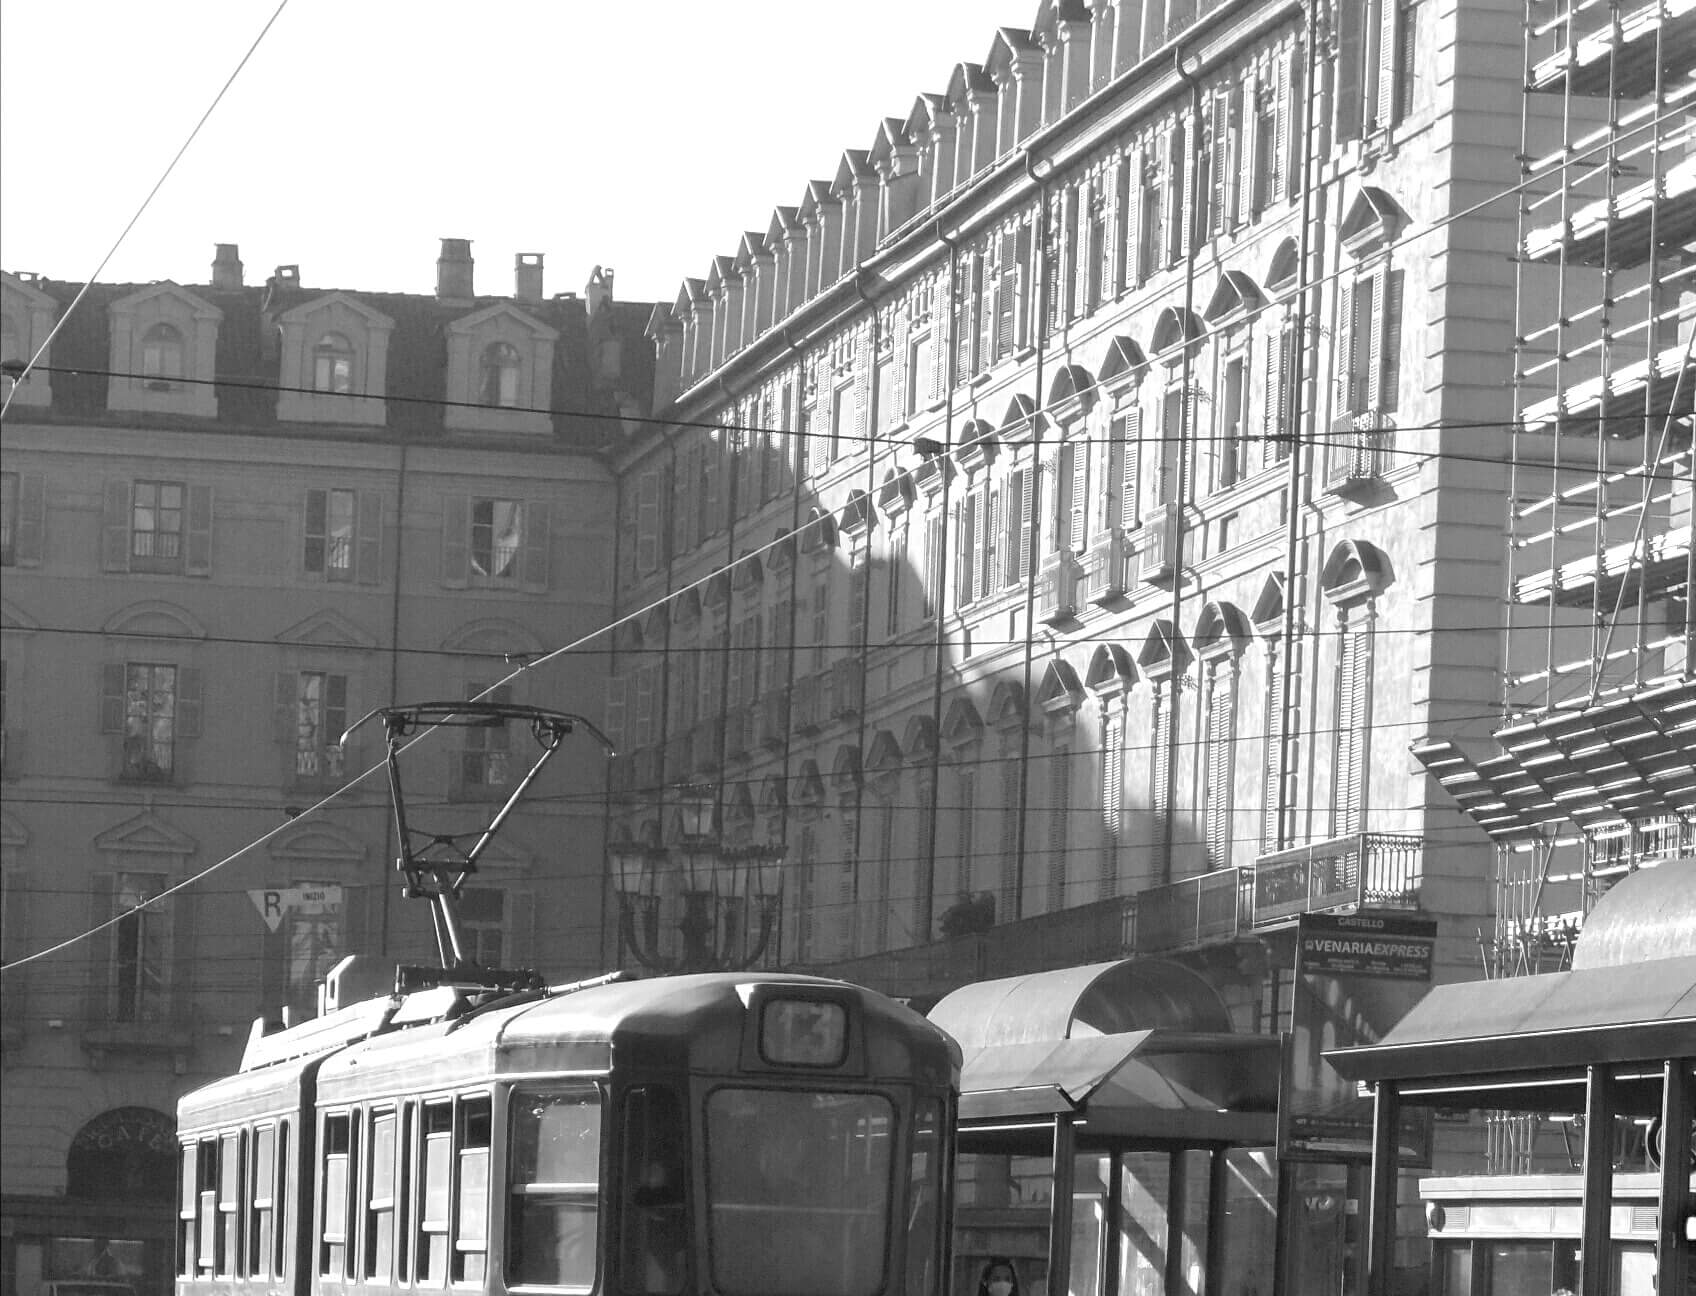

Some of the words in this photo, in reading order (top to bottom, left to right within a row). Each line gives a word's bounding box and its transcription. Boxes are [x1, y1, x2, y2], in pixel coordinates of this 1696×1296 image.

[303, 891, 325, 902] INIZIO
[264, 891, 281, 918] R
[1338, 917, 1385, 929] CASTELLO
